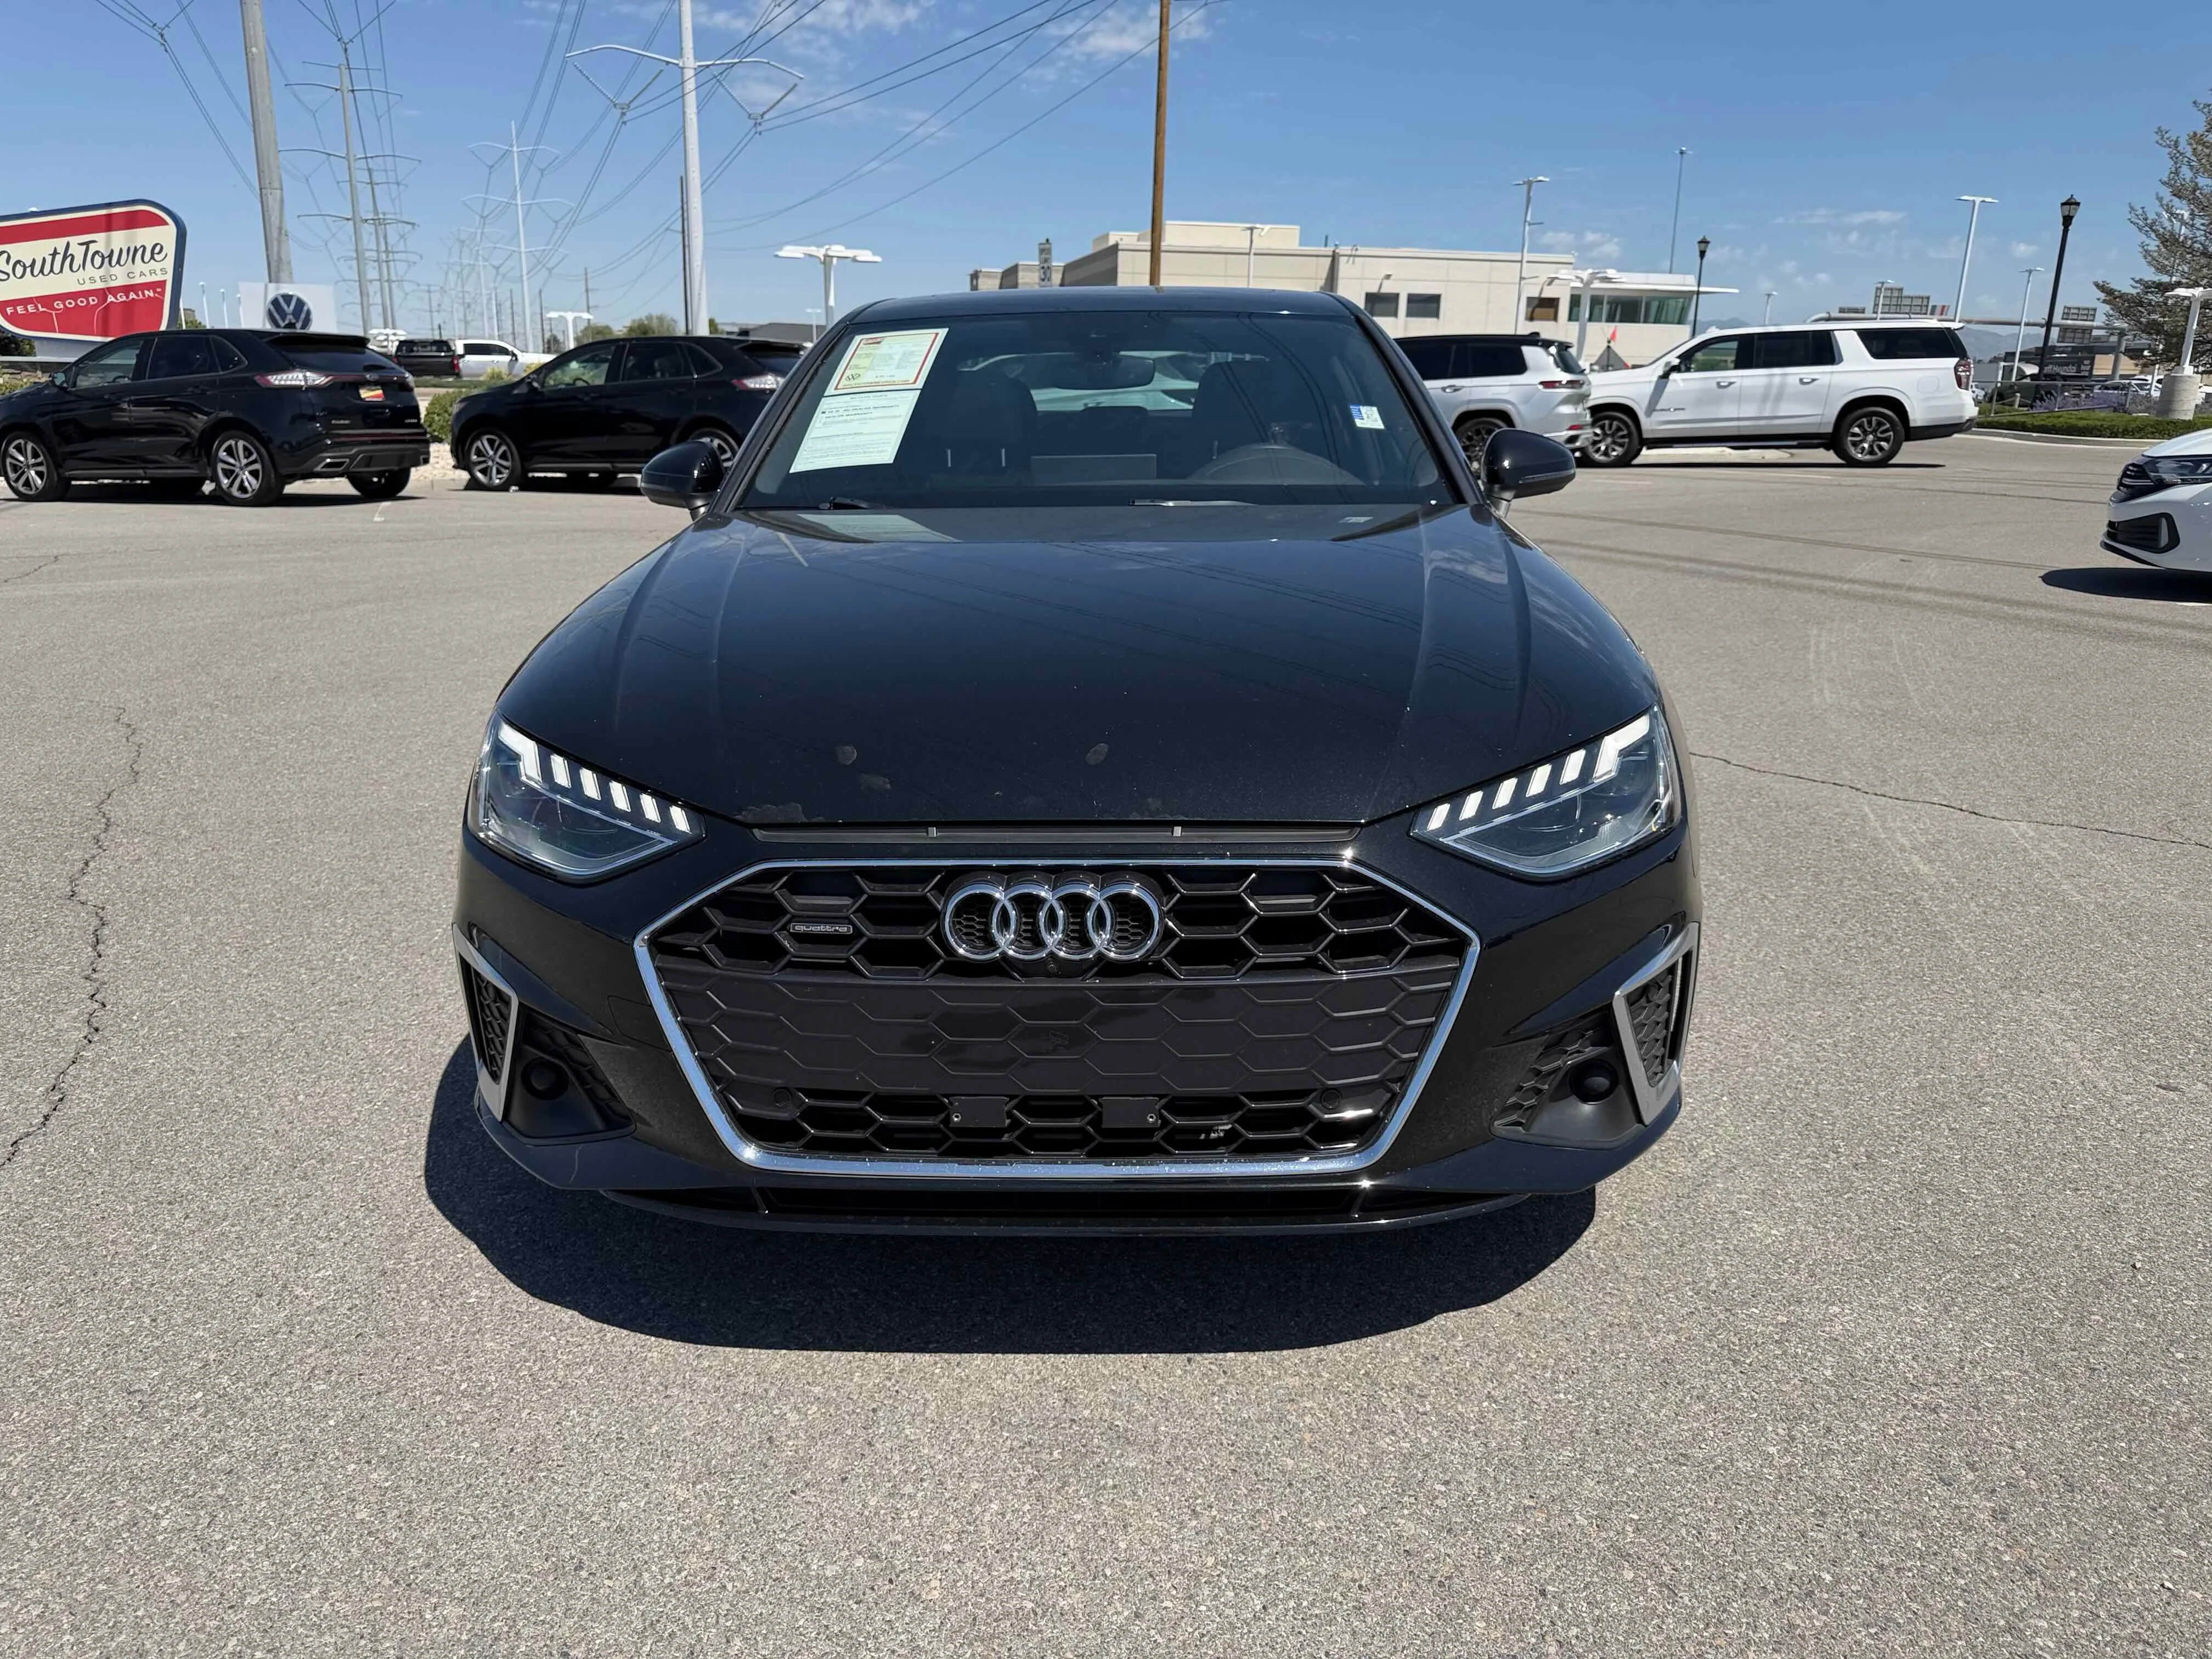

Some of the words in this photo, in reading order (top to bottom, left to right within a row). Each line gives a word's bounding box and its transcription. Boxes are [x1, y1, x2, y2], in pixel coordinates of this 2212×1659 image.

[0, 240, 167, 281] SouthTowne
[77, 274, 118, 285] USED
[127, 268, 168, 279] CARS
[6, 303, 47, 315] FEEL
[54, 296, 98, 309] GOOD
